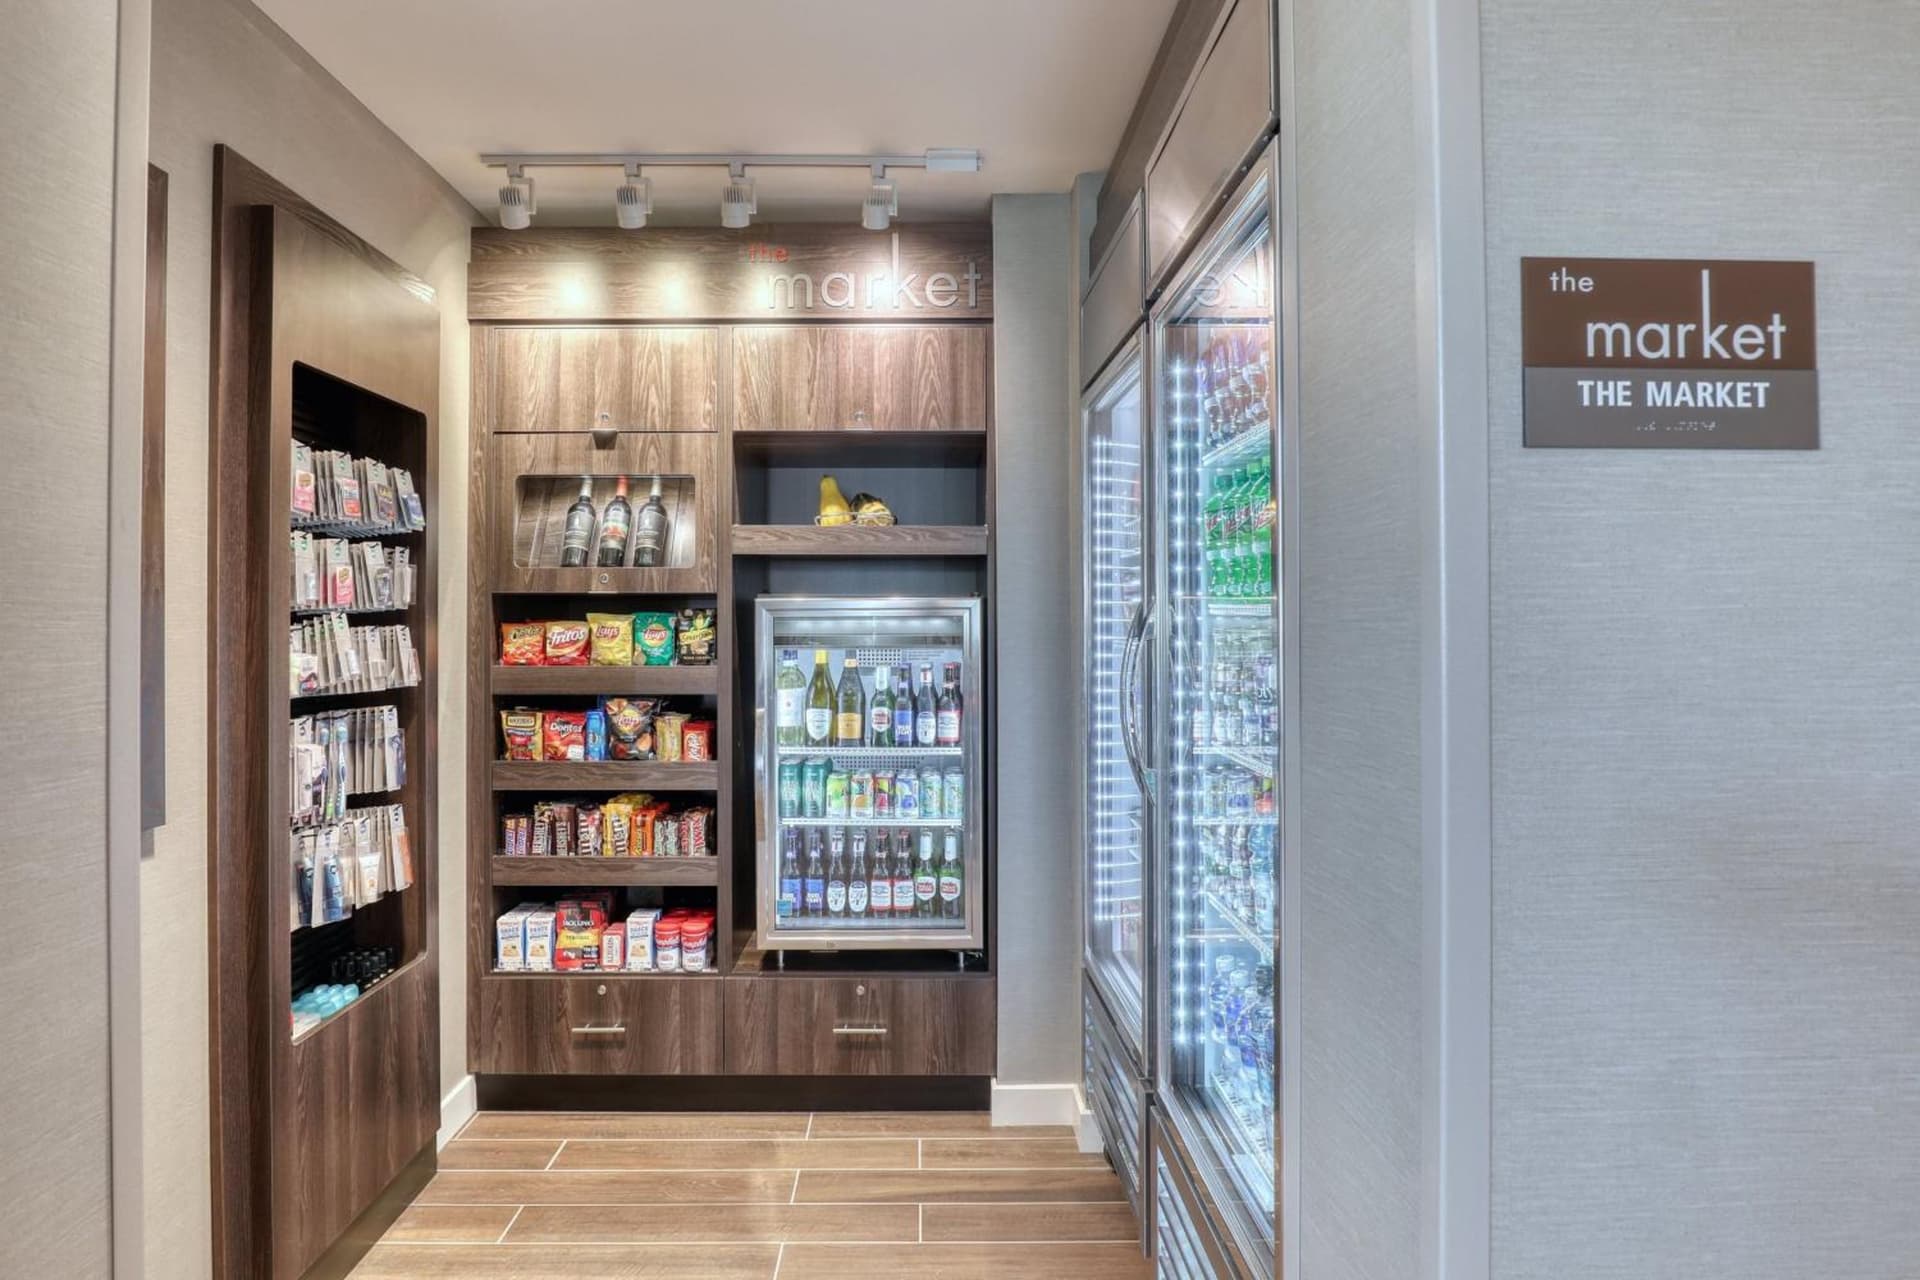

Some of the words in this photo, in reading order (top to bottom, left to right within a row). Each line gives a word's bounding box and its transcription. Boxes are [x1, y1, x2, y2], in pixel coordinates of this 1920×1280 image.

[768, 232, 982, 308] market
[1550, 267, 1594, 292] the
[1586, 269, 1787, 360] market
[1577, 380, 1632, 407] THE
[1646, 381, 1770, 408] MARKET
[551, 629, 585, 646] Fritos
[550, 722, 583, 734] Doritos
